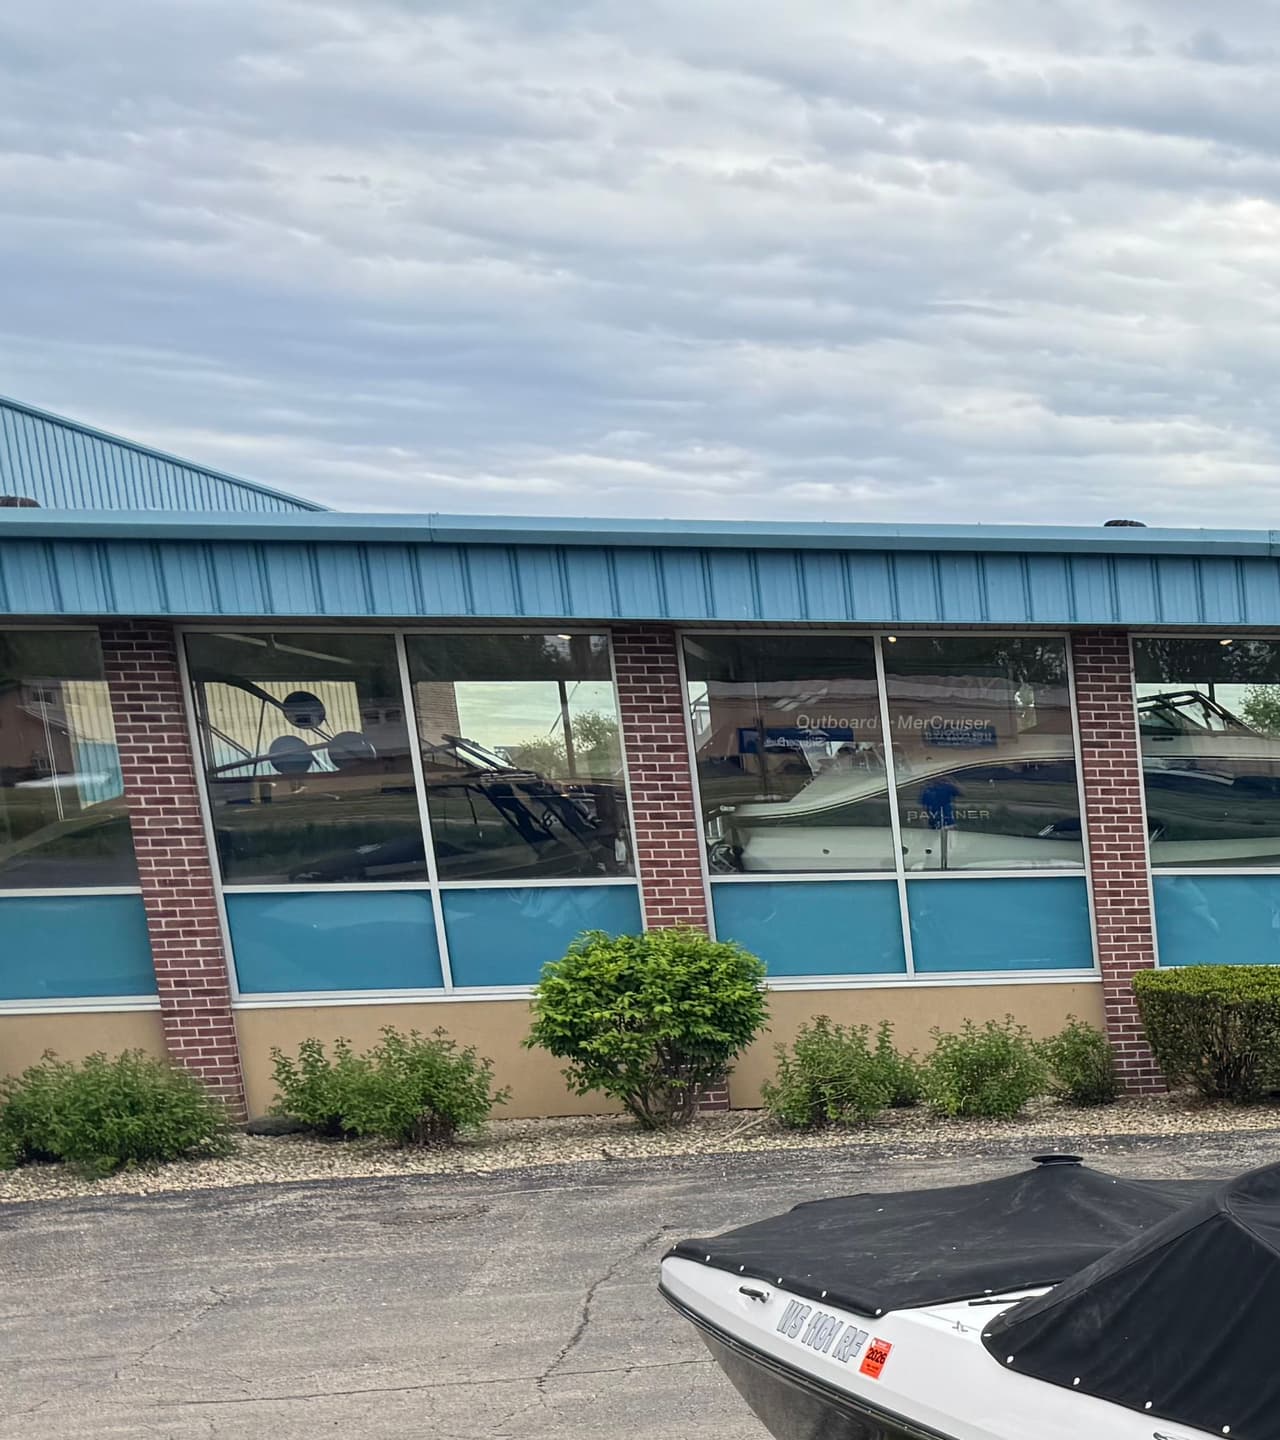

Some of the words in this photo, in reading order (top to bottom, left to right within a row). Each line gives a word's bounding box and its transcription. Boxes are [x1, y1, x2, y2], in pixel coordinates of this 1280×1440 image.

[796, 714, 880, 730] Outboard
[897, 715, 991, 730] MerCruiser
[776, 1299, 813, 1340] WS
[866, 1347, 888, 1365] 2026
